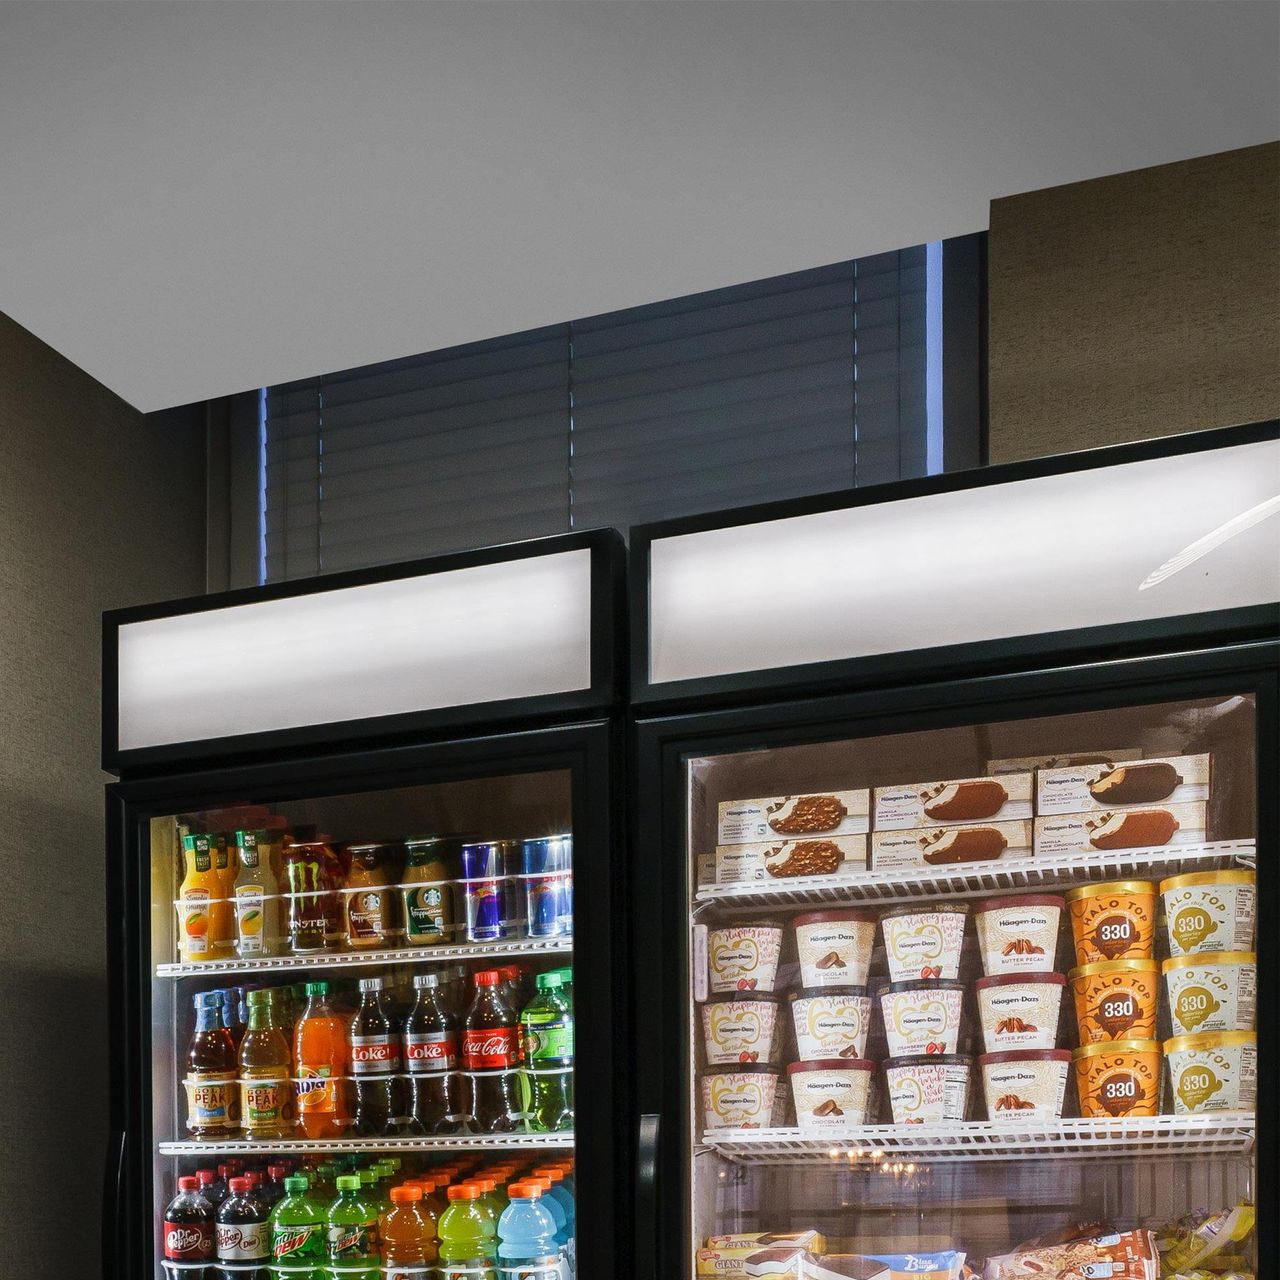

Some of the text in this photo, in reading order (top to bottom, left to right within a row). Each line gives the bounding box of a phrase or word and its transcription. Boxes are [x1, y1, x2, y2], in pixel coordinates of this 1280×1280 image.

[810, 934, 856, 944] Häagen-Dazs
[1101, 924, 1131, 941] 330
[1104, 1001, 1134, 1018] 330
[1181, 995, 1208, 1013] 330
[352, 1046, 386, 1061] Coke
[462, 1036, 510, 1057] Coca-Cola
[807, 1081, 852, 1091] Häagen-Dazs
[1184, 1073, 1210, 1091] 330
[195, 1093, 226, 1105] PEAK
[248, 1094, 279, 1106] PEAK
[168, 1231, 200, 1250] Pepper
